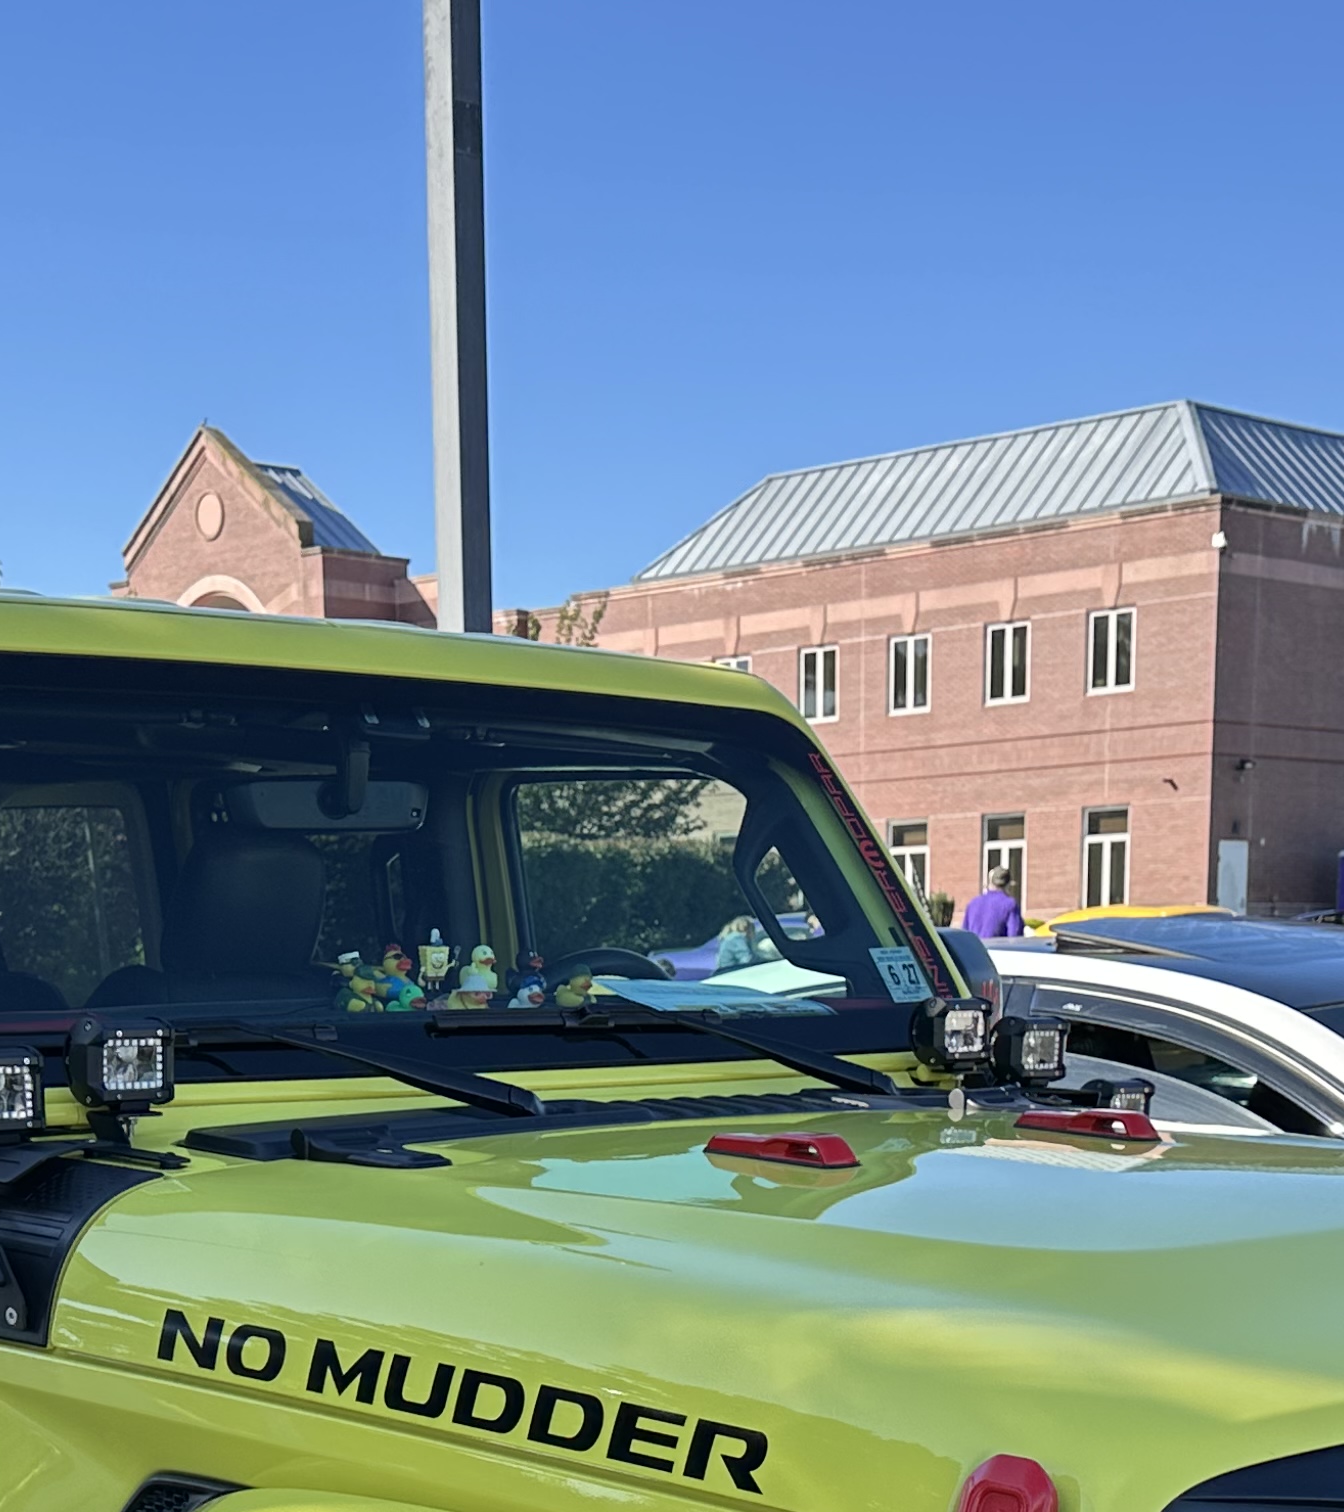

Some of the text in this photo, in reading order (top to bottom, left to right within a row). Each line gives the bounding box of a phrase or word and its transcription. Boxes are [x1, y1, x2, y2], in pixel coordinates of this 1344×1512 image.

[887, 963, 920, 986] 6 27
[157, 1308, 769, 1495] NO MUDDER
